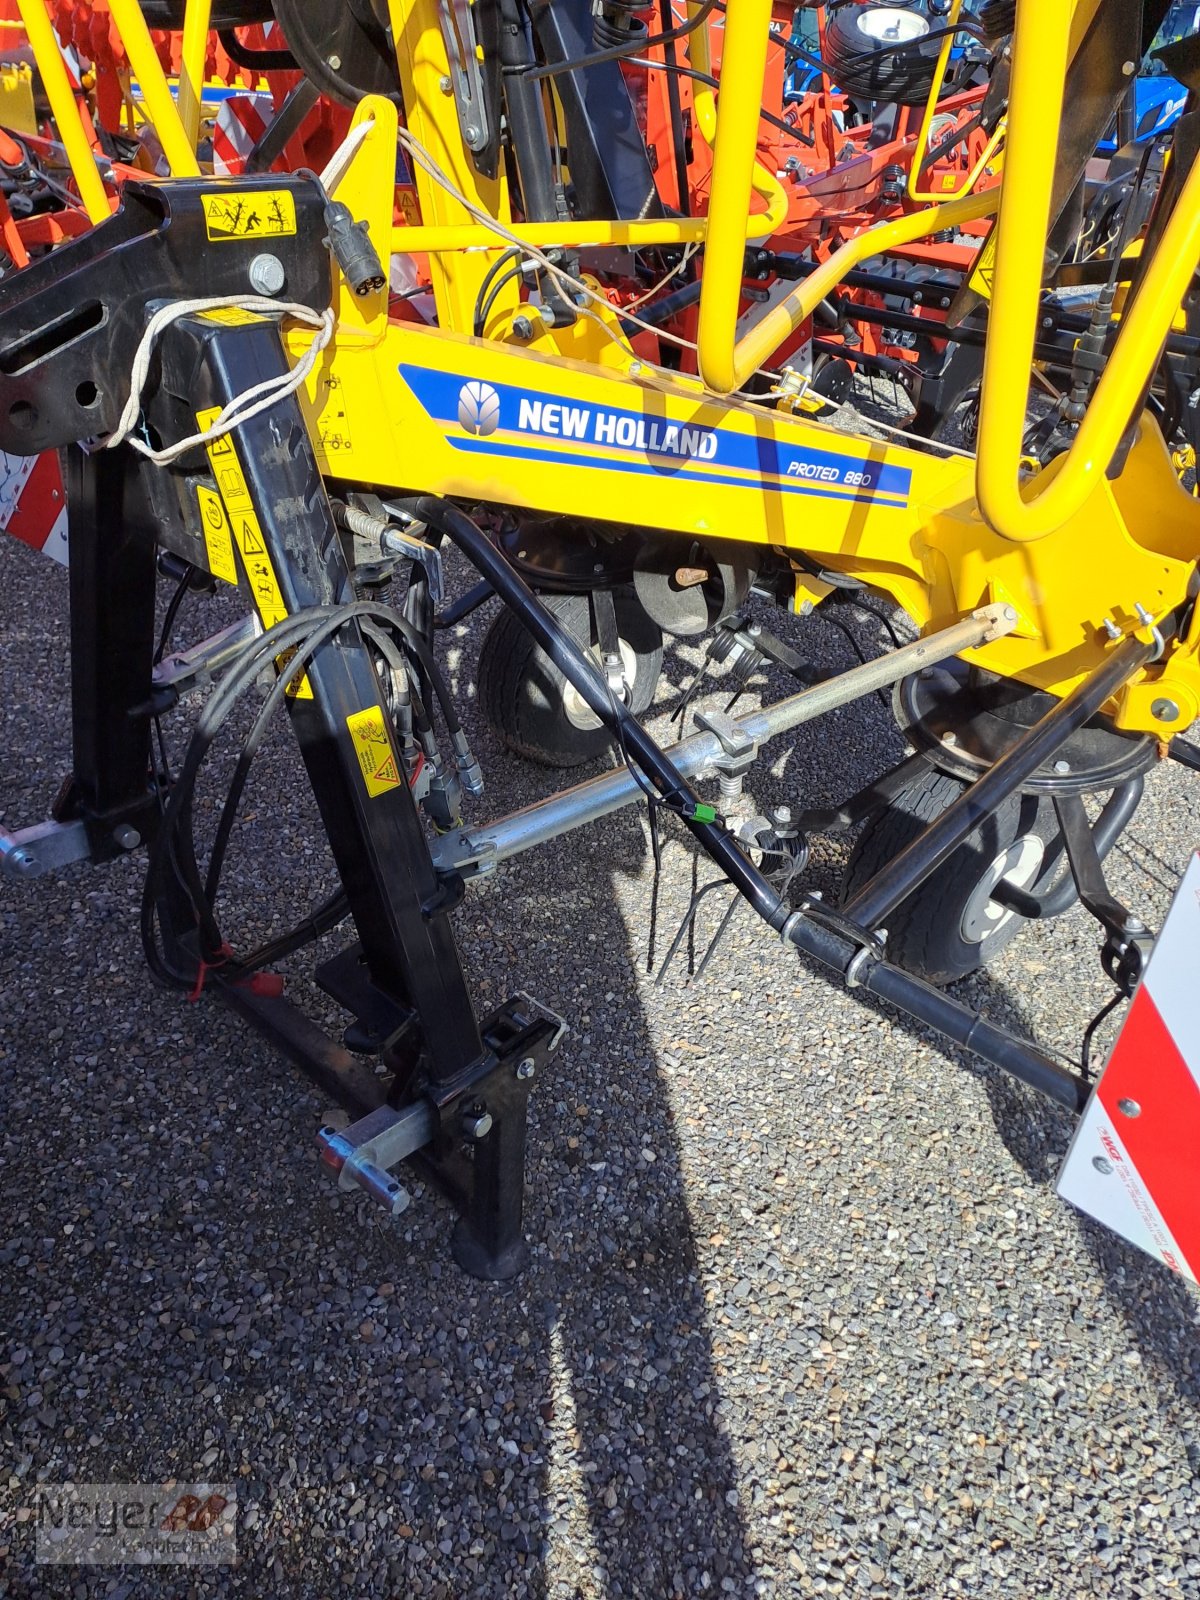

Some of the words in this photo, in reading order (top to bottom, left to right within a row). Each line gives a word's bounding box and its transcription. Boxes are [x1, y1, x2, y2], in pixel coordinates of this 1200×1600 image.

[518, 398, 590, 439] NEW
[594, 412, 718, 459] HOLLAND
[787, 461, 839, 481] PROTED
[844, 471, 872, 486] 880
[1101, 1135, 1123, 1162] WGF
